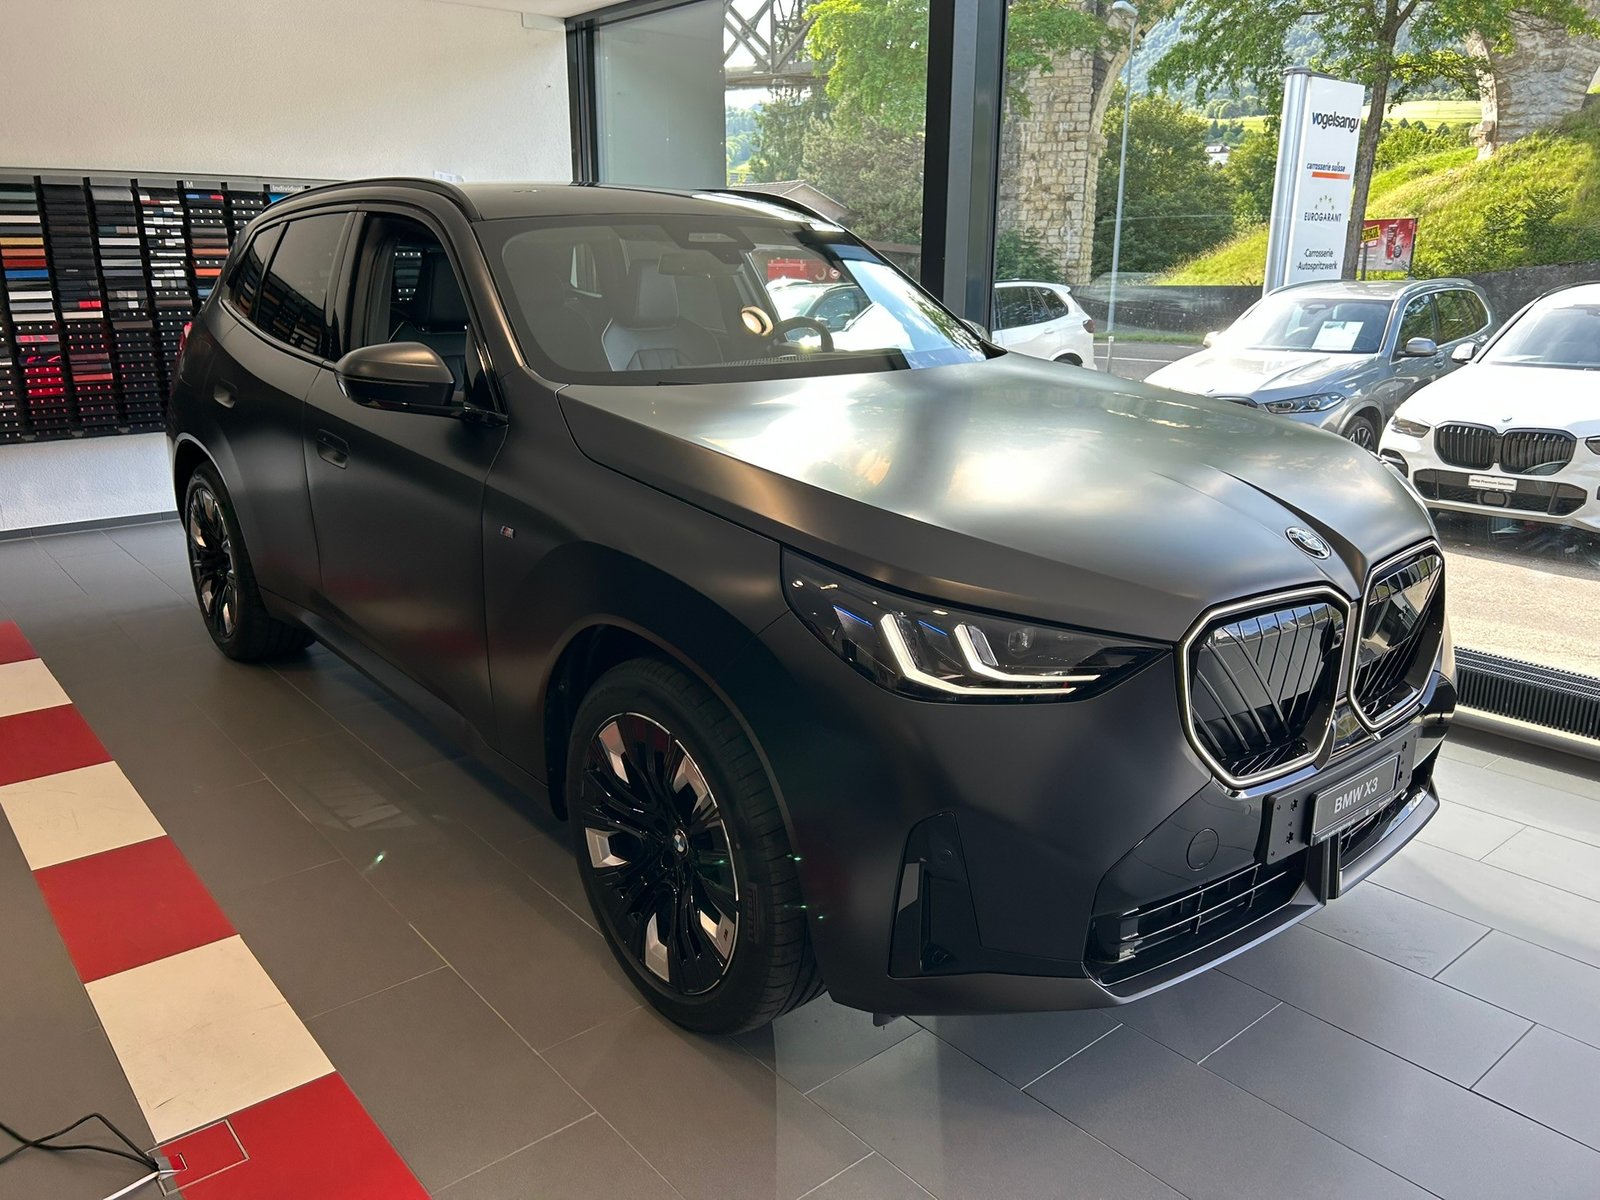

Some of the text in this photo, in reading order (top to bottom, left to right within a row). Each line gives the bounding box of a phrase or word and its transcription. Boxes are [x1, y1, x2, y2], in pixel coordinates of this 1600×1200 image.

[272, 184, 303, 192] Individual
[1304, 212, 1342, 222] EUROGARANT
[1334, 784, 1364, 814] BMW
[1363, 776, 1379, 798] X3
